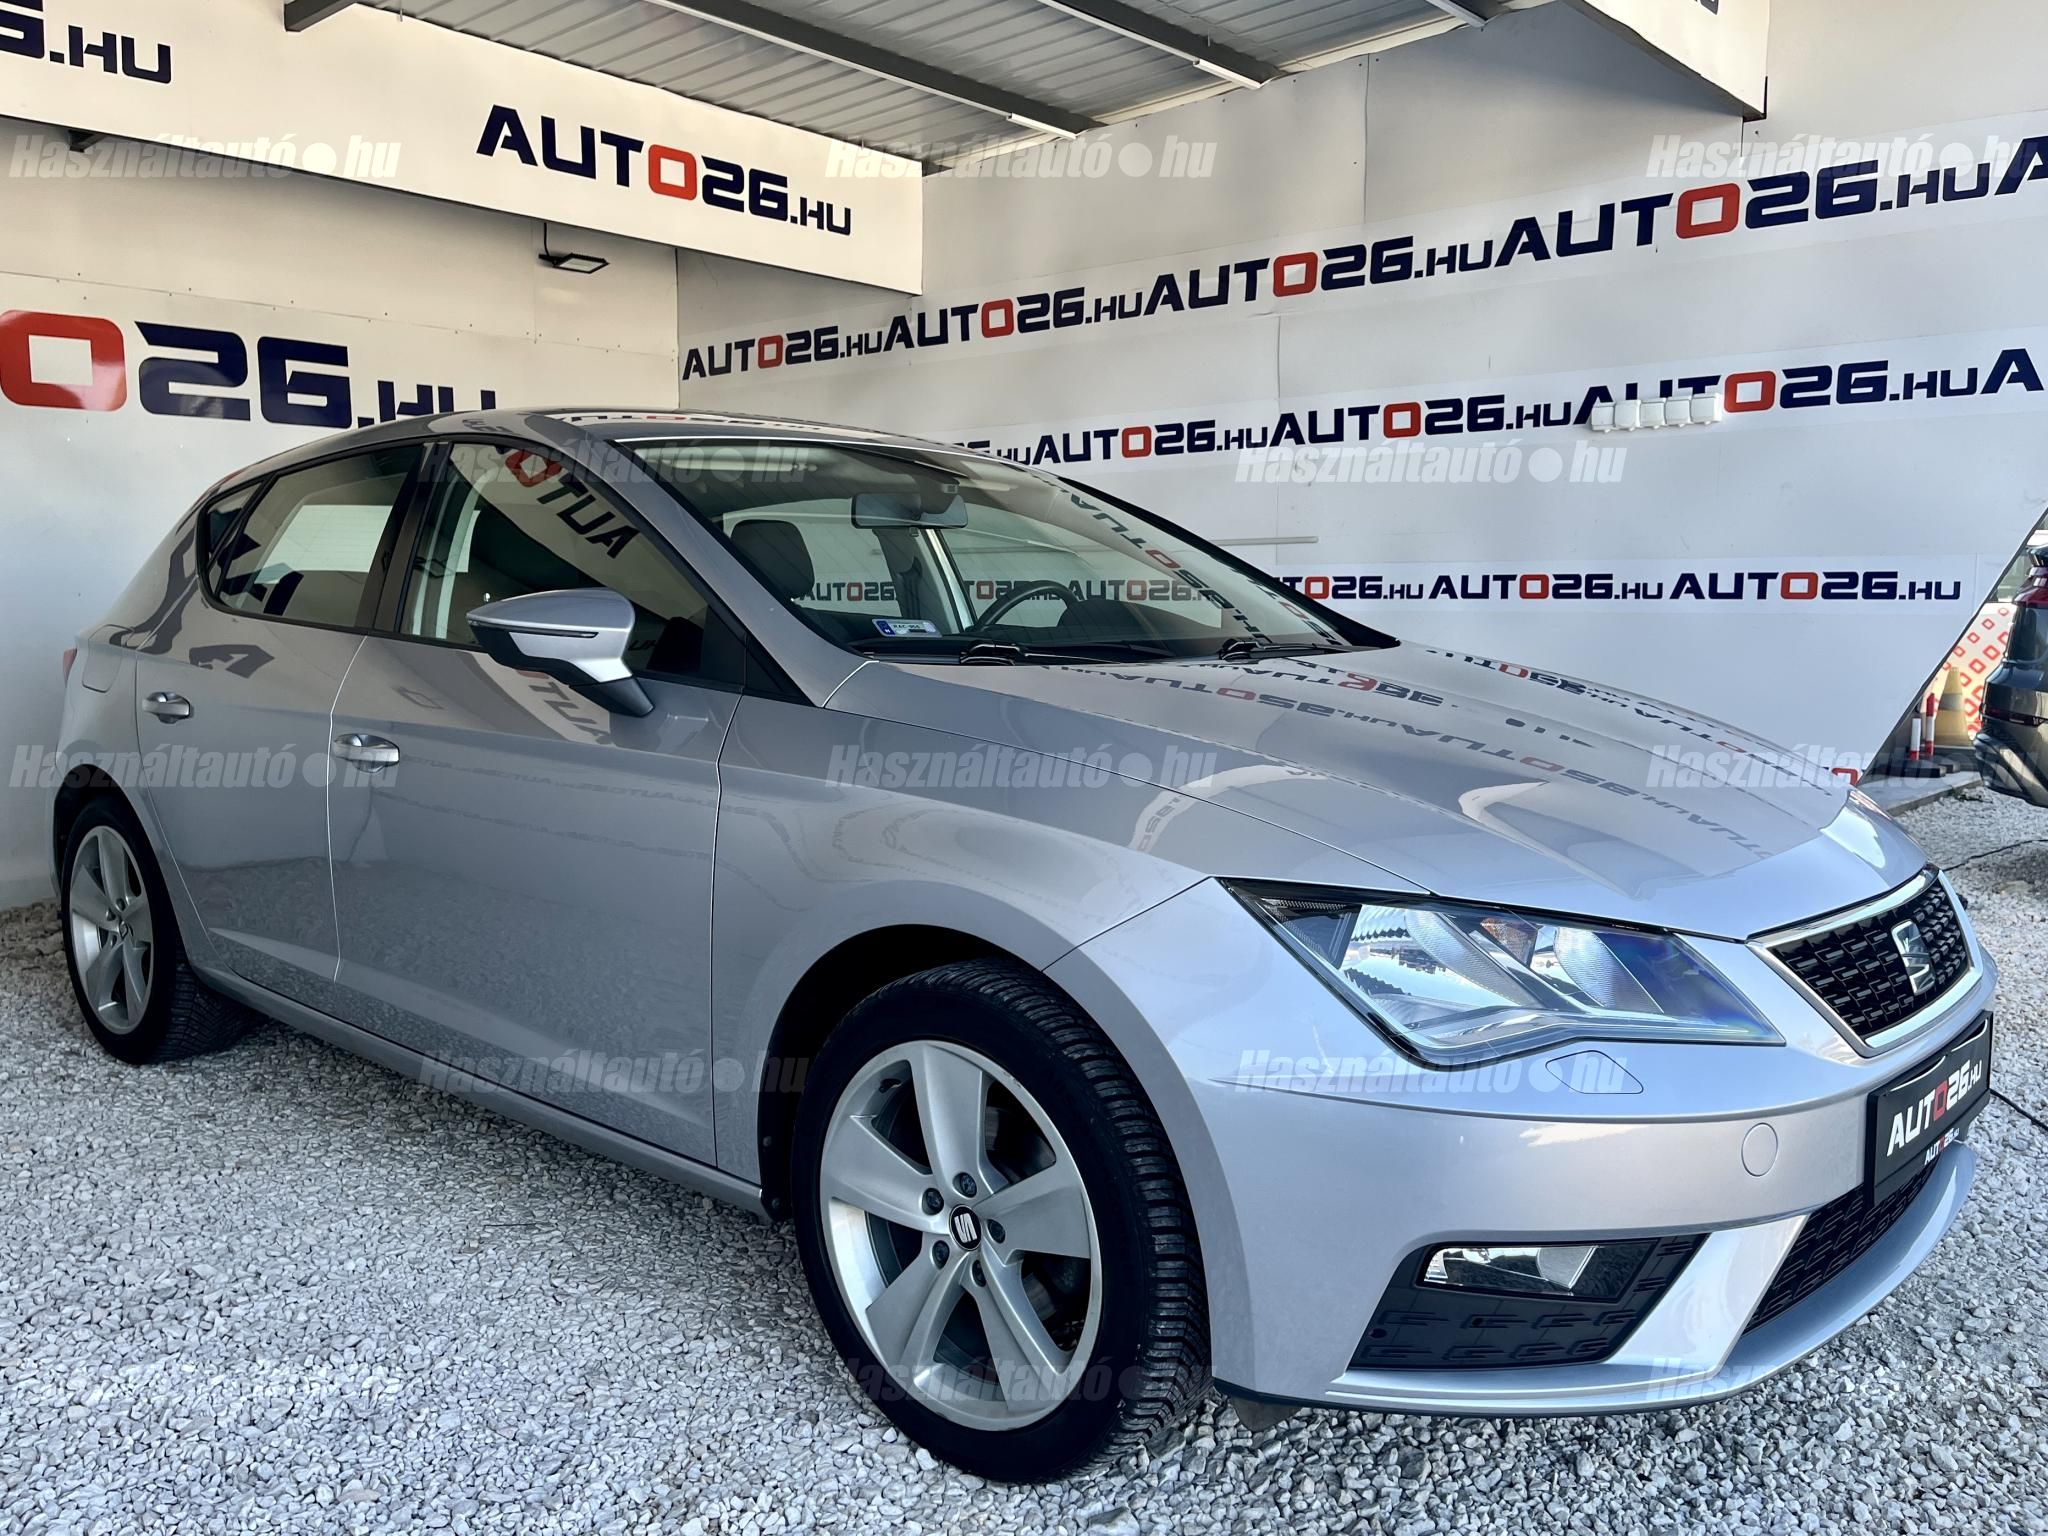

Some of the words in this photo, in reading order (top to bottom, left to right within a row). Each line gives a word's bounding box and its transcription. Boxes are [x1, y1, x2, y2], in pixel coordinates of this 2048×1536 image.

[476, 104, 851, 235] AUTO26.HU
[682, 325, 883, 380] AUTO26.HU
[884, 287, 1143, 351] AUTO26.HU
[1144, 236, 1493, 315] AUTO26.HU
[1494, 160, 1990, 267] AUTO26.HU
[1032, 420, 1268, 465] AUTO26.HU
[1269, 394, 1571, 447] AUTO26.HU
[1272, 575, 1424, 600] TO26.HU
[1428, 573, 1662, 600] AUTO26.HU
[1669, 570, 1961, 600] AUTO26.HU
[1887, 1060, 1982, 1157] AUTO26.HU
